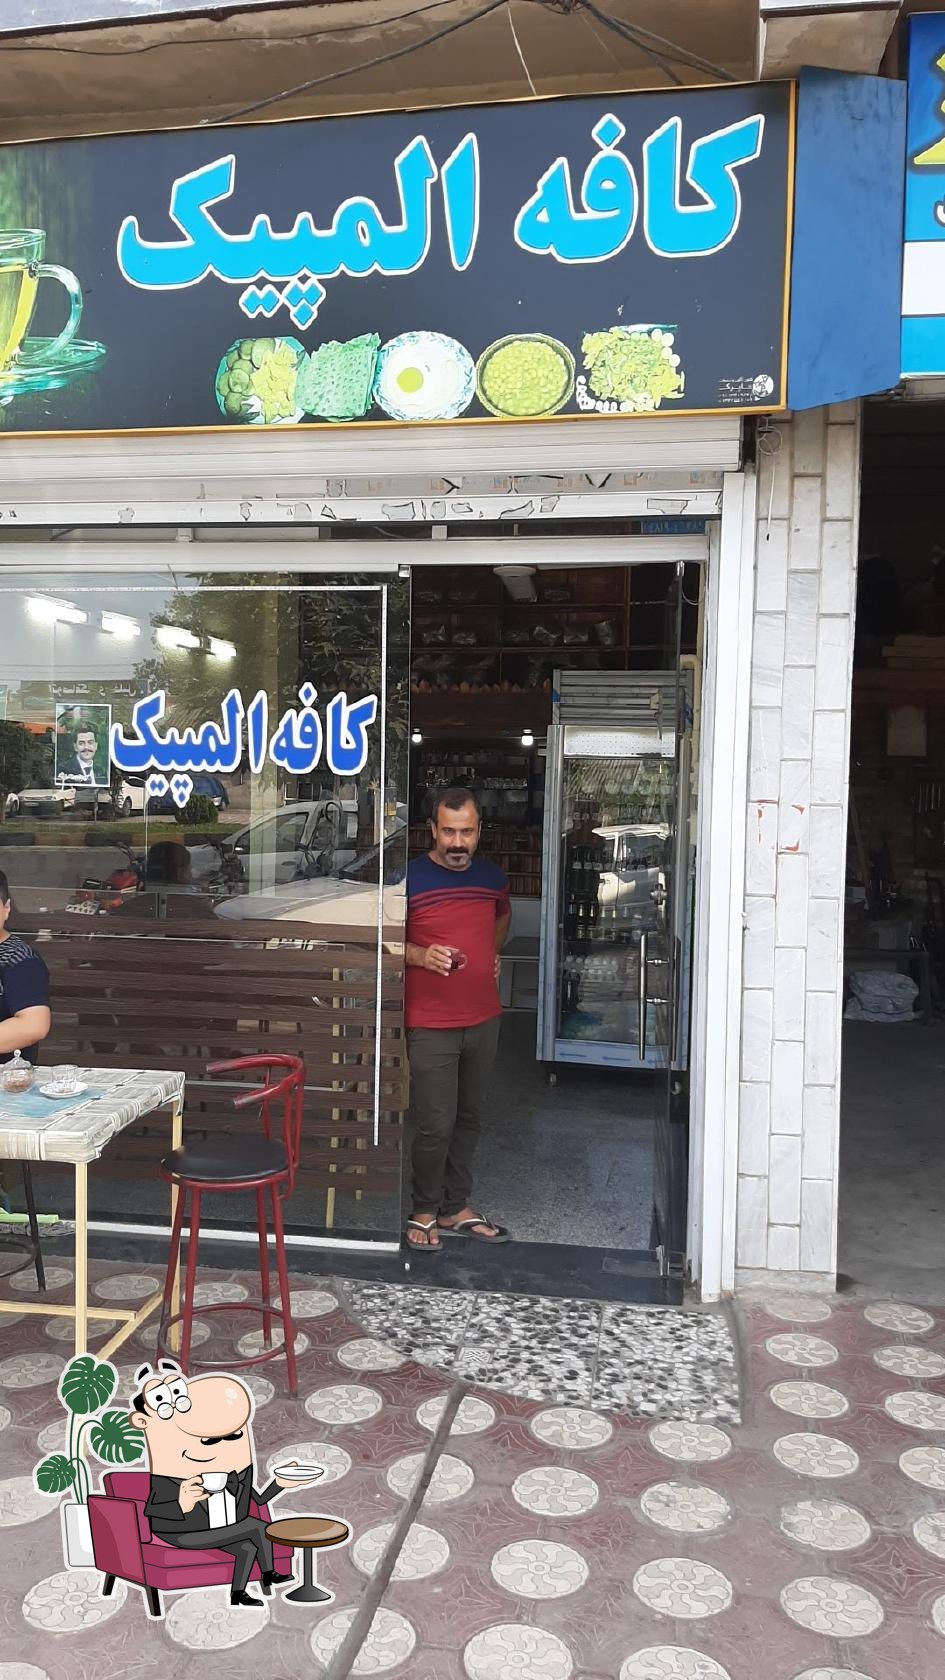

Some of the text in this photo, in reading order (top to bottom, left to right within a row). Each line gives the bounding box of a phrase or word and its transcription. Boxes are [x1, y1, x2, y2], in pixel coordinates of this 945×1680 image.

[117, 113, 765, 330] کافه المپیک
[111, 682, 377, 808] کافه المپیک
